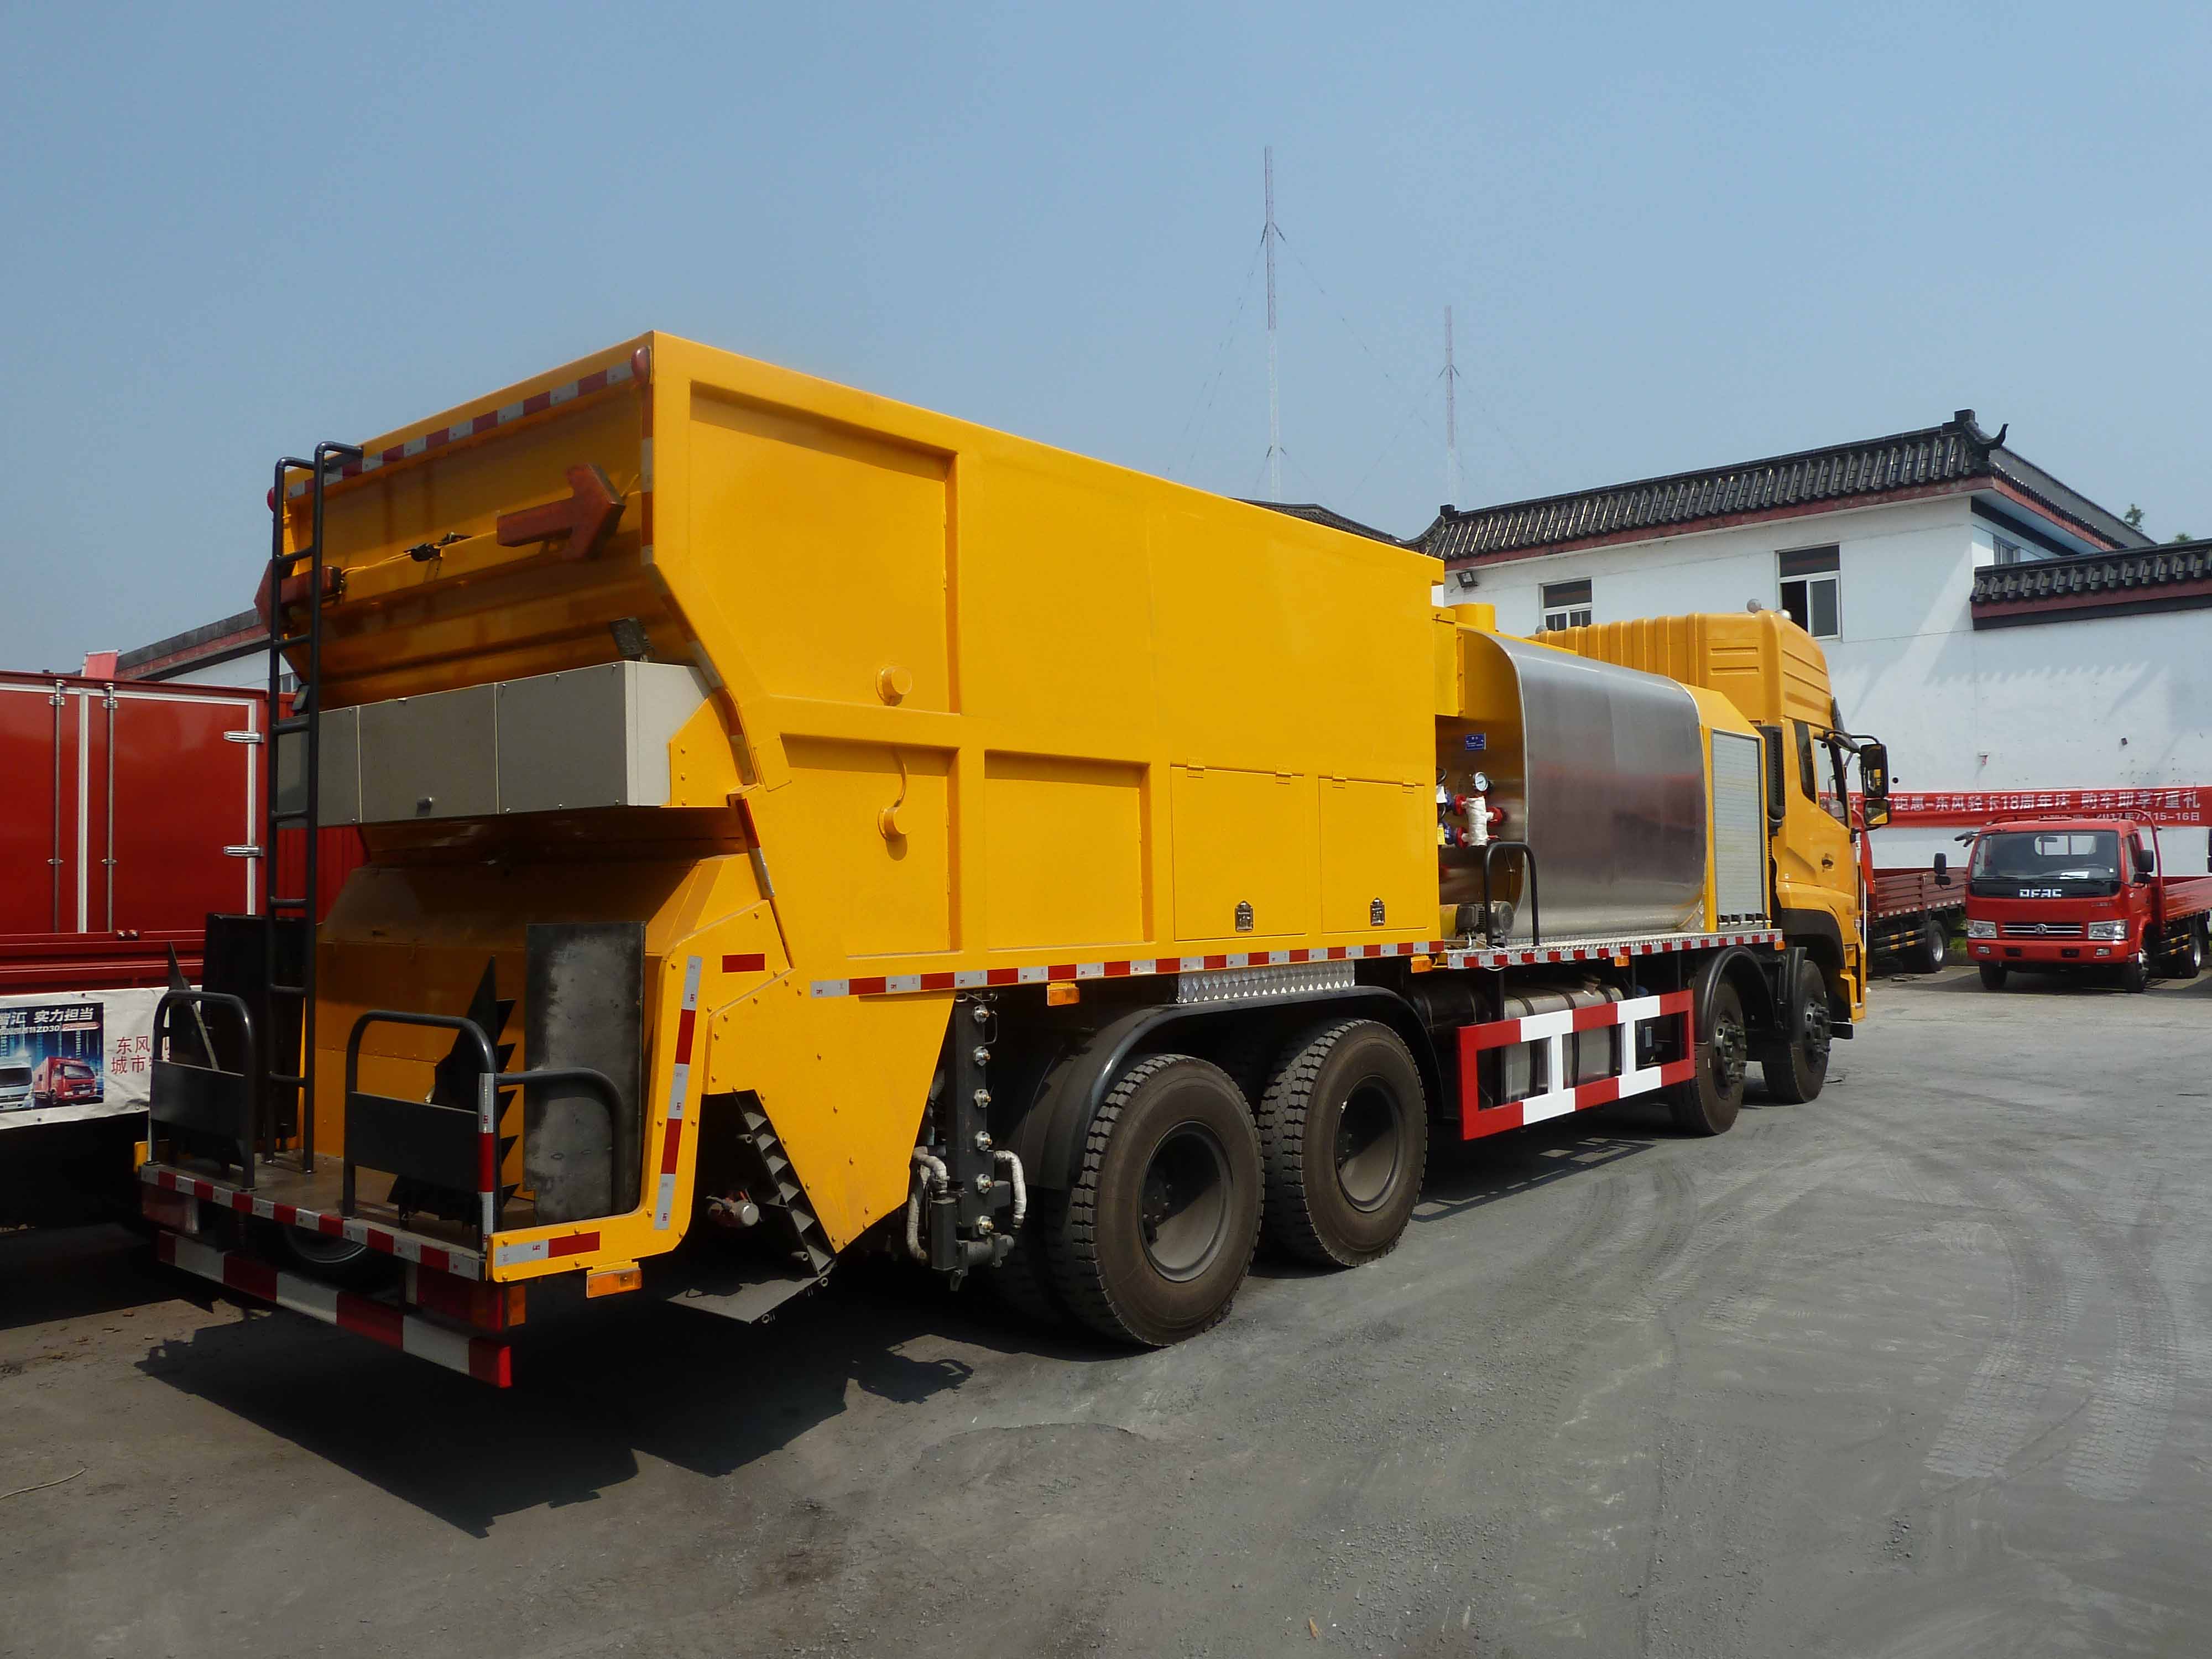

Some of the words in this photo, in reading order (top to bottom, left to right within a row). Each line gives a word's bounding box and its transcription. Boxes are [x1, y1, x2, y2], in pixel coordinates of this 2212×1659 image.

[2019, 889, 2062, 898] DFAC
[34, 1008, 93, 1023] 实力担当
[116, 1035, 169, 1055] 东风
[111, 1055, 154, 1074] 城市
